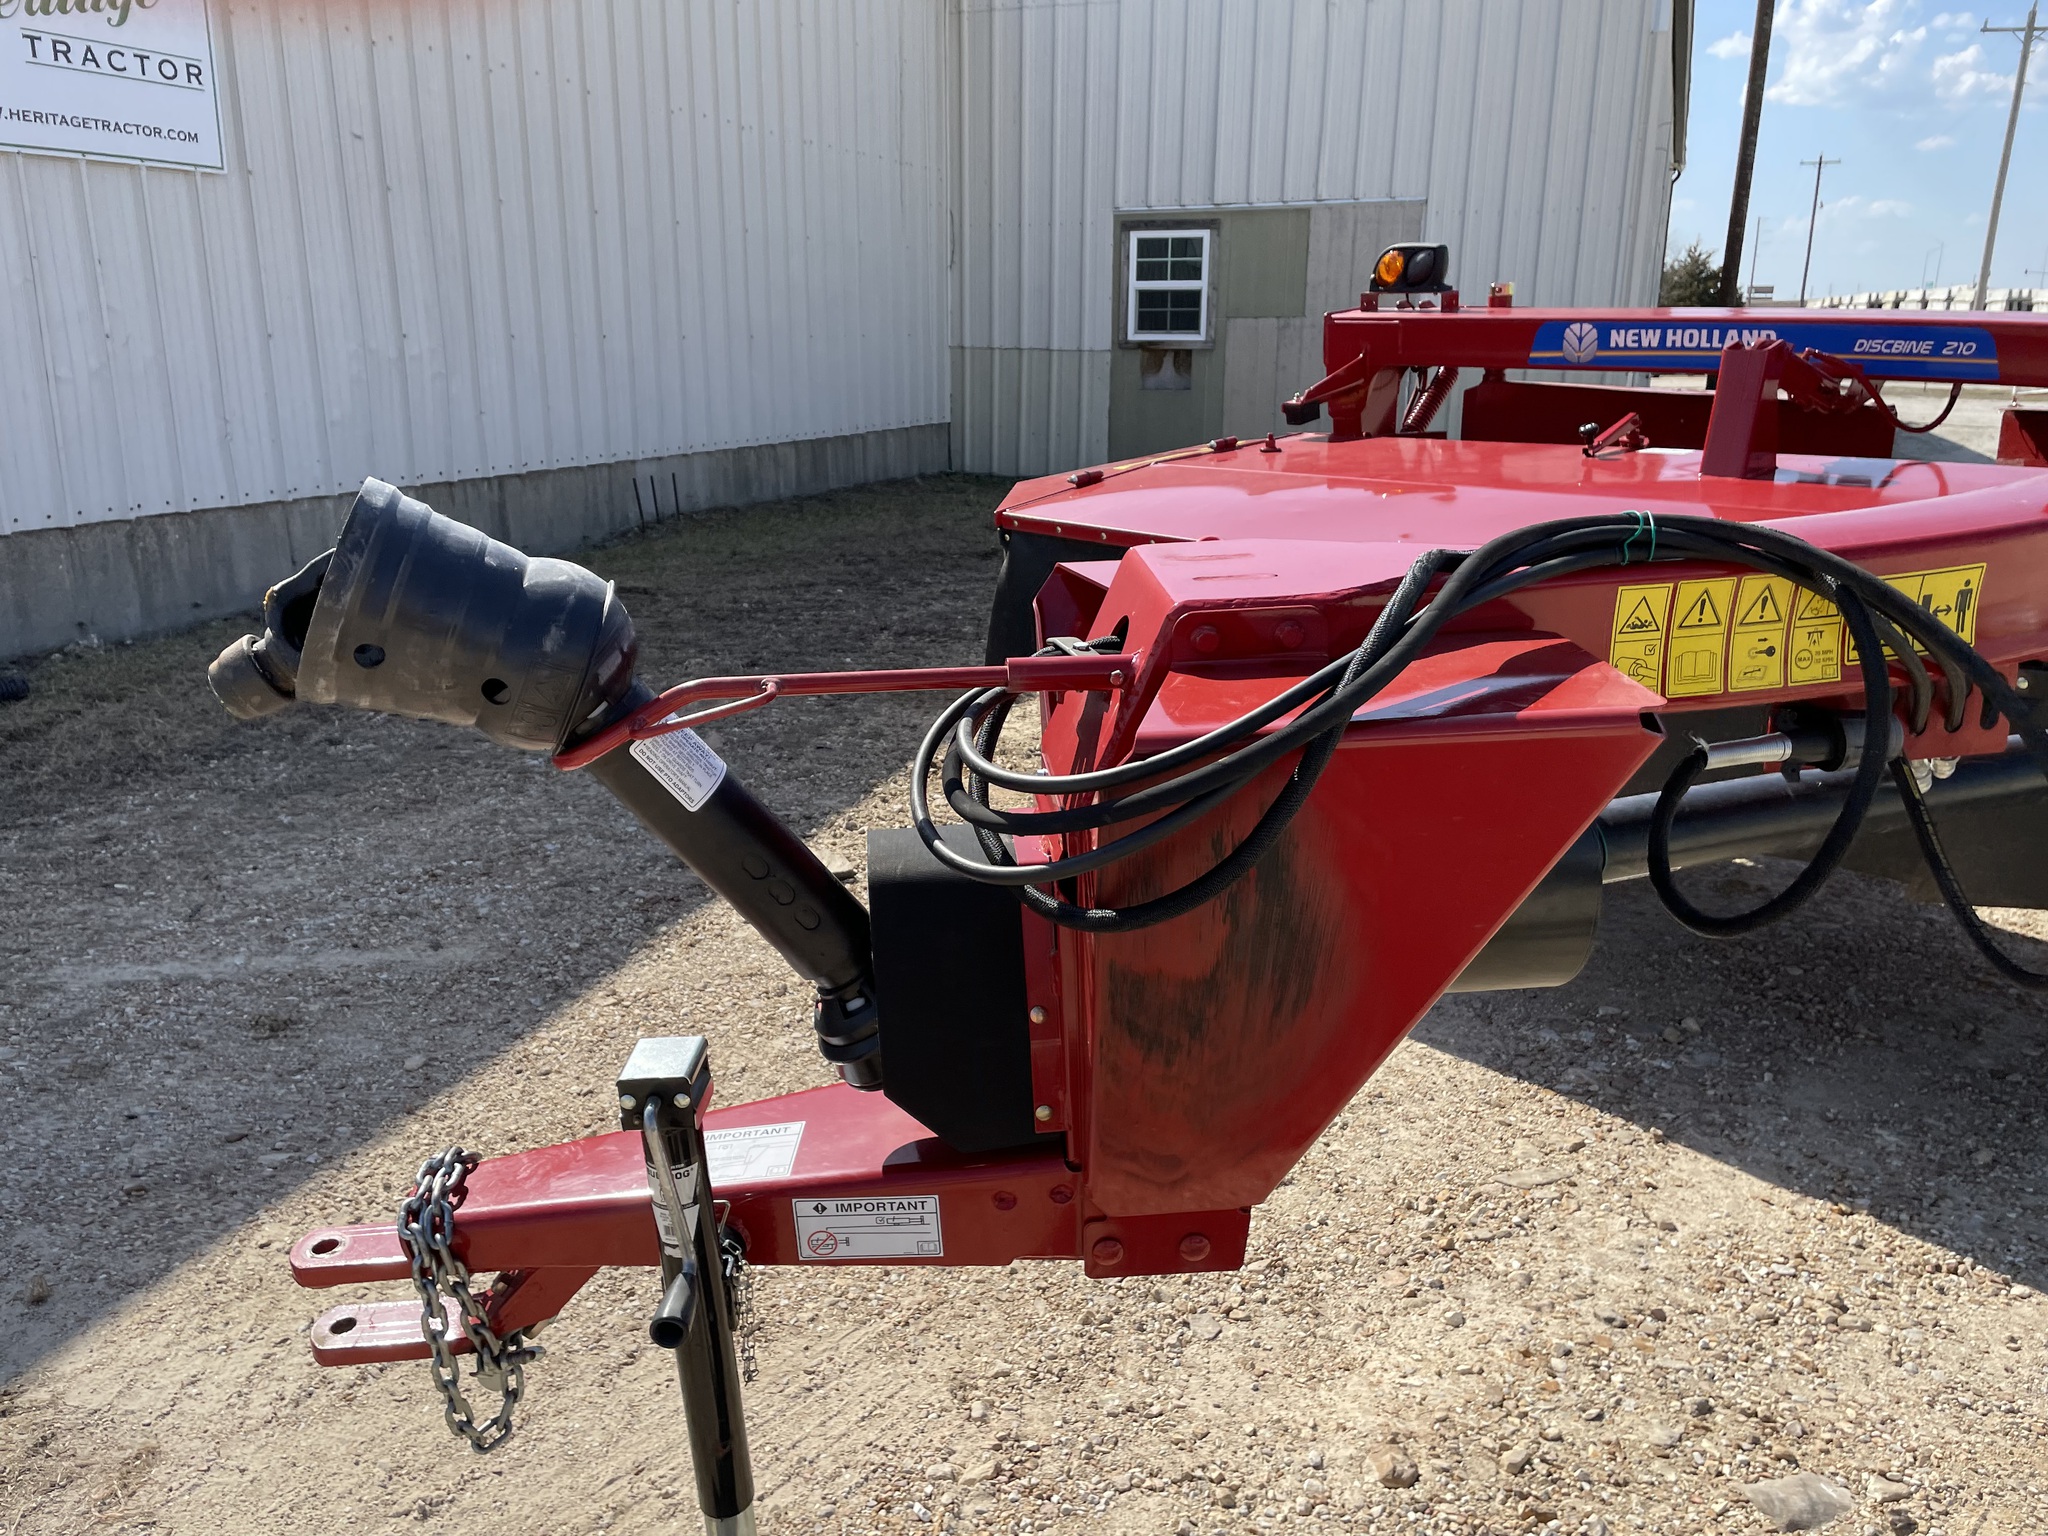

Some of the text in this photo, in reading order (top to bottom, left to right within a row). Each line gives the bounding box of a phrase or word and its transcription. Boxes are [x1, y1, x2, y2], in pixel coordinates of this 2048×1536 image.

[22, 33, 203, 86] TRACTOR
[0, 107, 199, 143] .HERITAGETRACTOR.COM
[1610, 328, 1661, 348] NEW
[1853, 339, 1977, 355] DISCBINE 210
[638, 748, 695, 803] DO NOT USE PTO ADAPTORS
[706, 1126, 791, 1141] IMPORTANT
[835, 1200, 928, 1213] IMPORTANT
